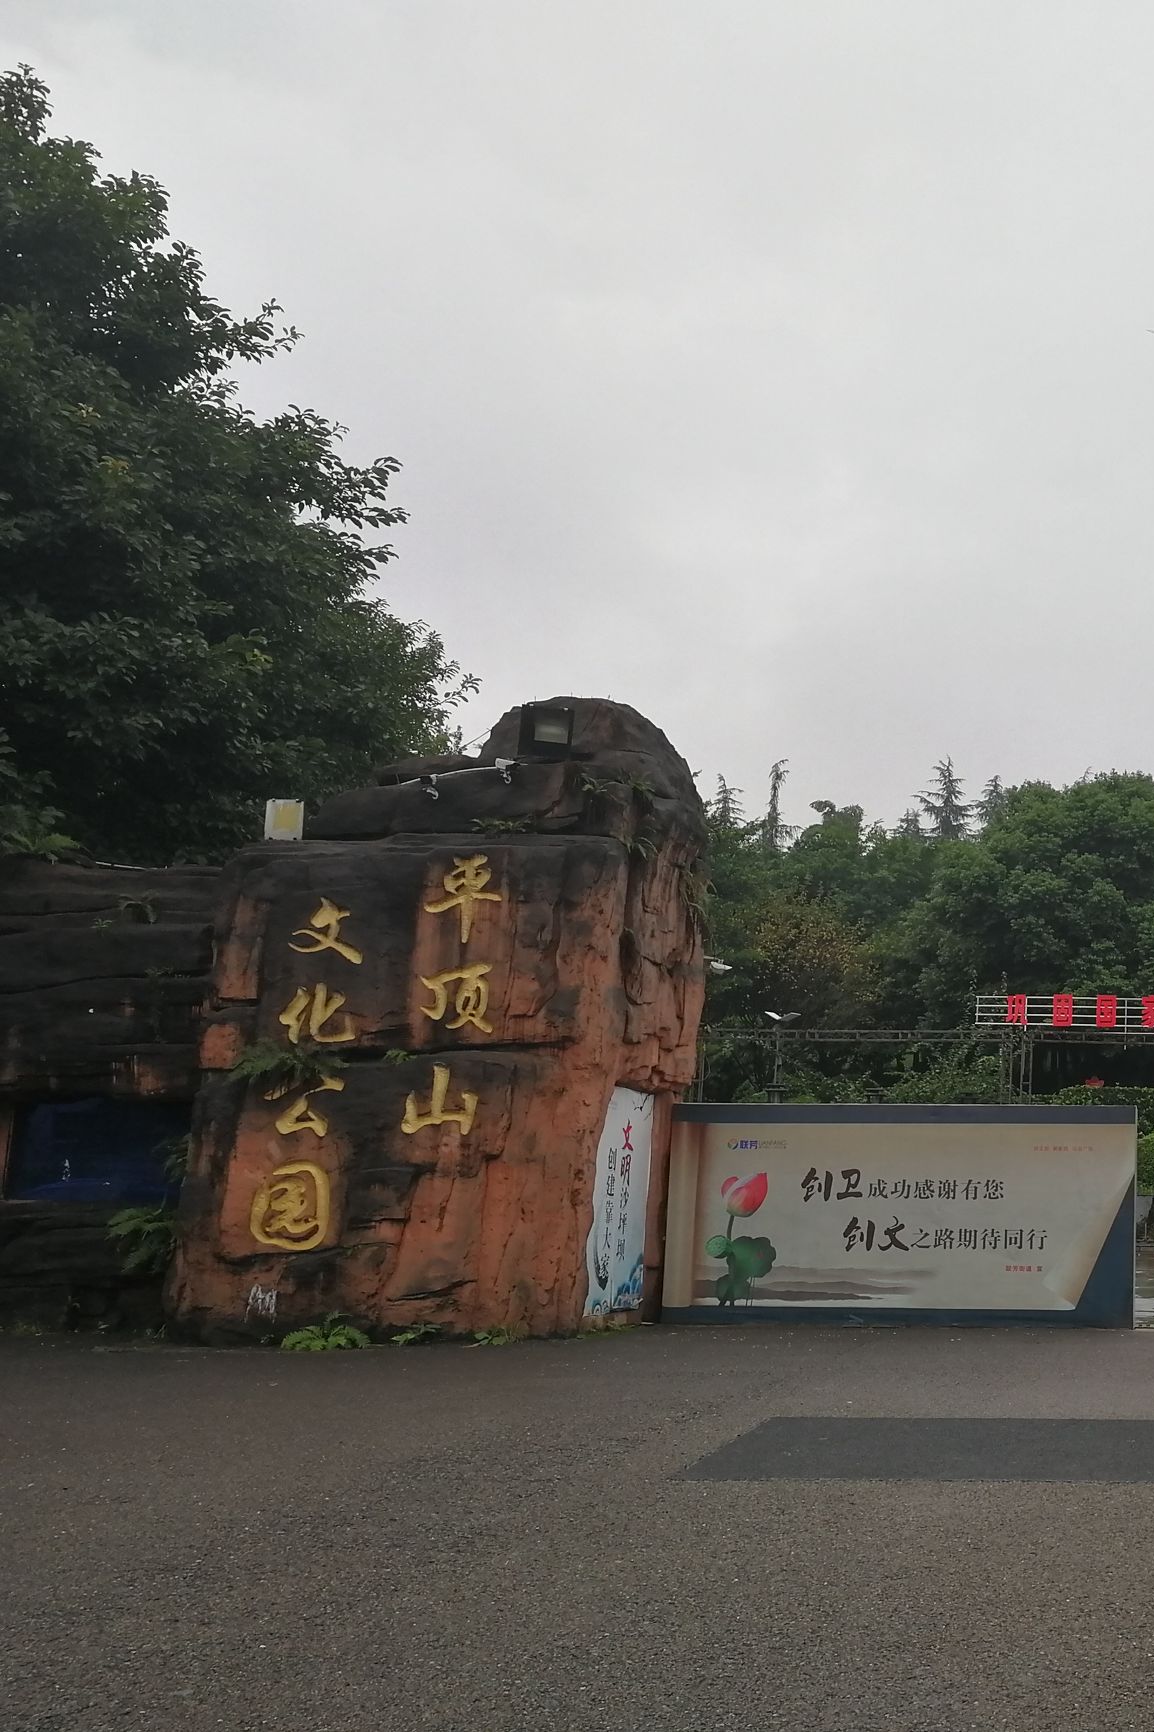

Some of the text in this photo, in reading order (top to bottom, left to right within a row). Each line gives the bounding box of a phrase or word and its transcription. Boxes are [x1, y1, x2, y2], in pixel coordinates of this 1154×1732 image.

[250, 896, 364, 1252] 文化公园
[599, 1147, 617, 1279] 创建靠大家
[616, 1119, 634, 1262] 文明沙坪坝
[801, 1167, 1005, 1202] 创卫成功感谢有您
[843, 1215, 1048, 1252] 创文之路期待同行
